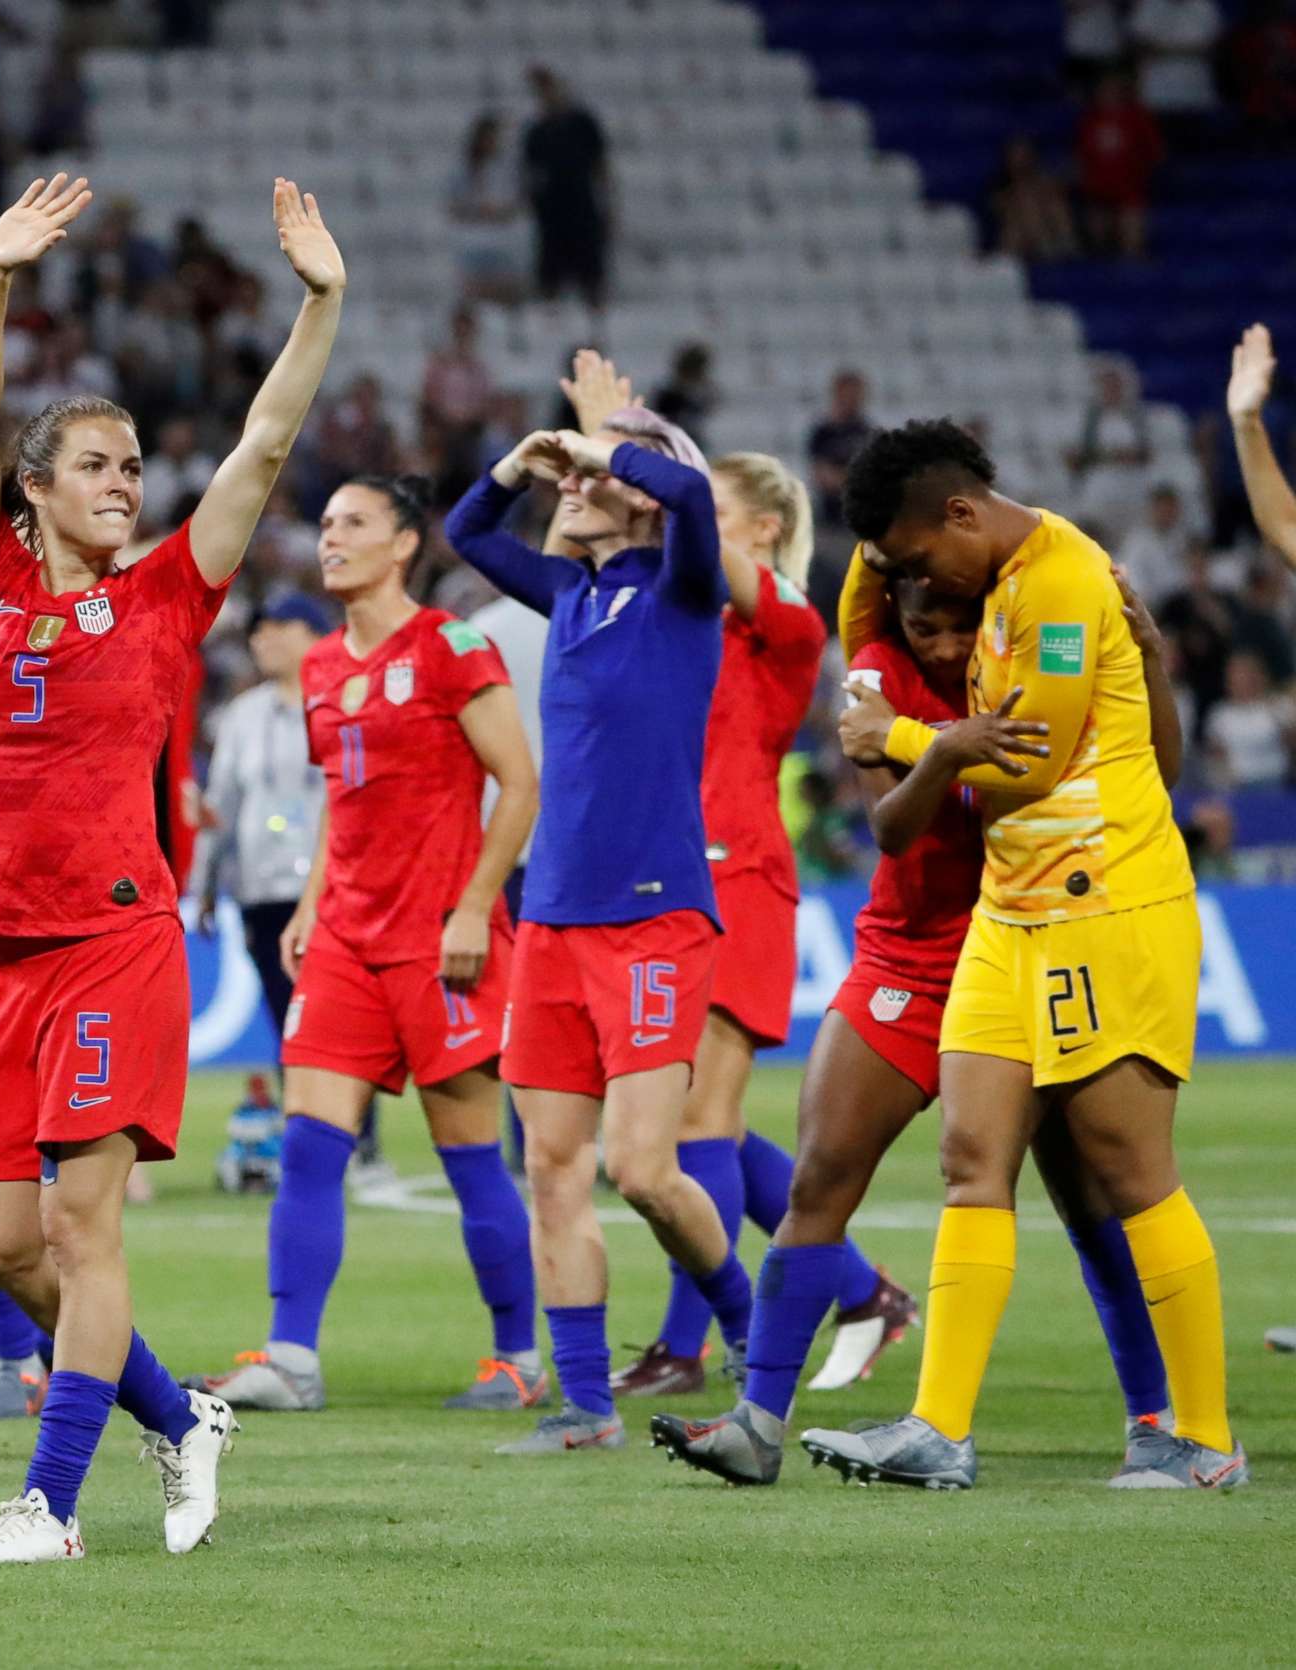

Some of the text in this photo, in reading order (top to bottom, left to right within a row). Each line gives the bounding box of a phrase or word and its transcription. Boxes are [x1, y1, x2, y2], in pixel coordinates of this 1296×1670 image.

[78, 601, 108, 617] USA
[11, 653, 49, 723] 5
[338, 724, 366, 787] 11
[629, 962, 676, 1027] 15
[1047, 965, 1099, 1036] 21
[76, 1012, 110, 1085] 5
